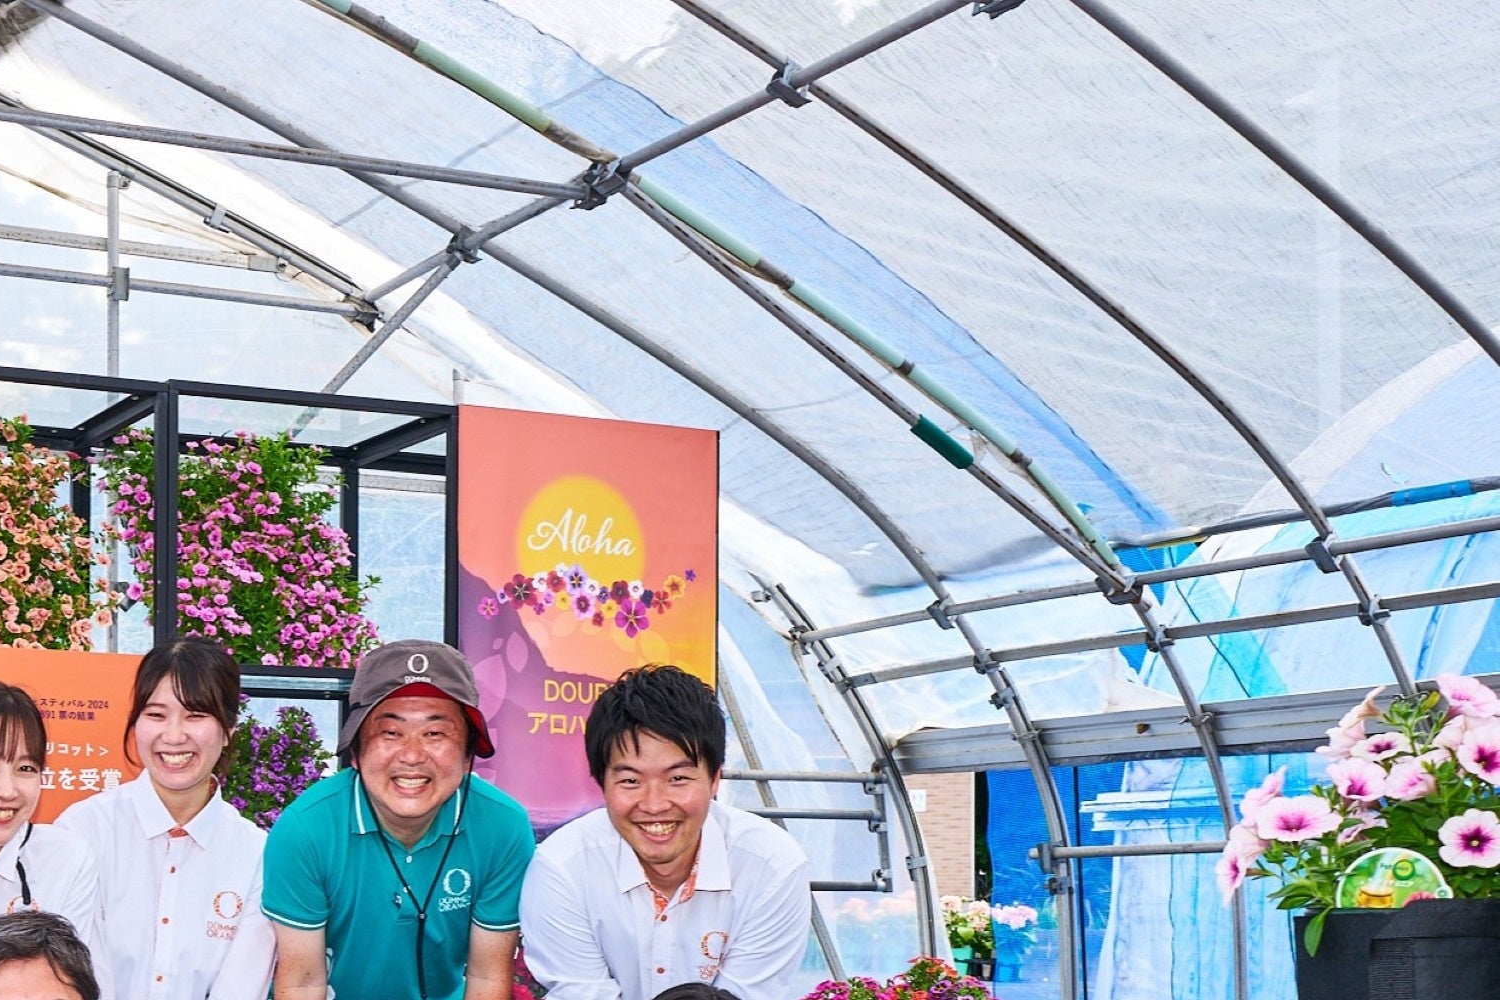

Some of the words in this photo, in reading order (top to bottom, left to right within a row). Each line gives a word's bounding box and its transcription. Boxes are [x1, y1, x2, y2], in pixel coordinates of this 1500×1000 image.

[527, 508, 636, 556] Aloha
[87, 699, 110, 710] 2024
[527, 712, 587, 735] アロハ
